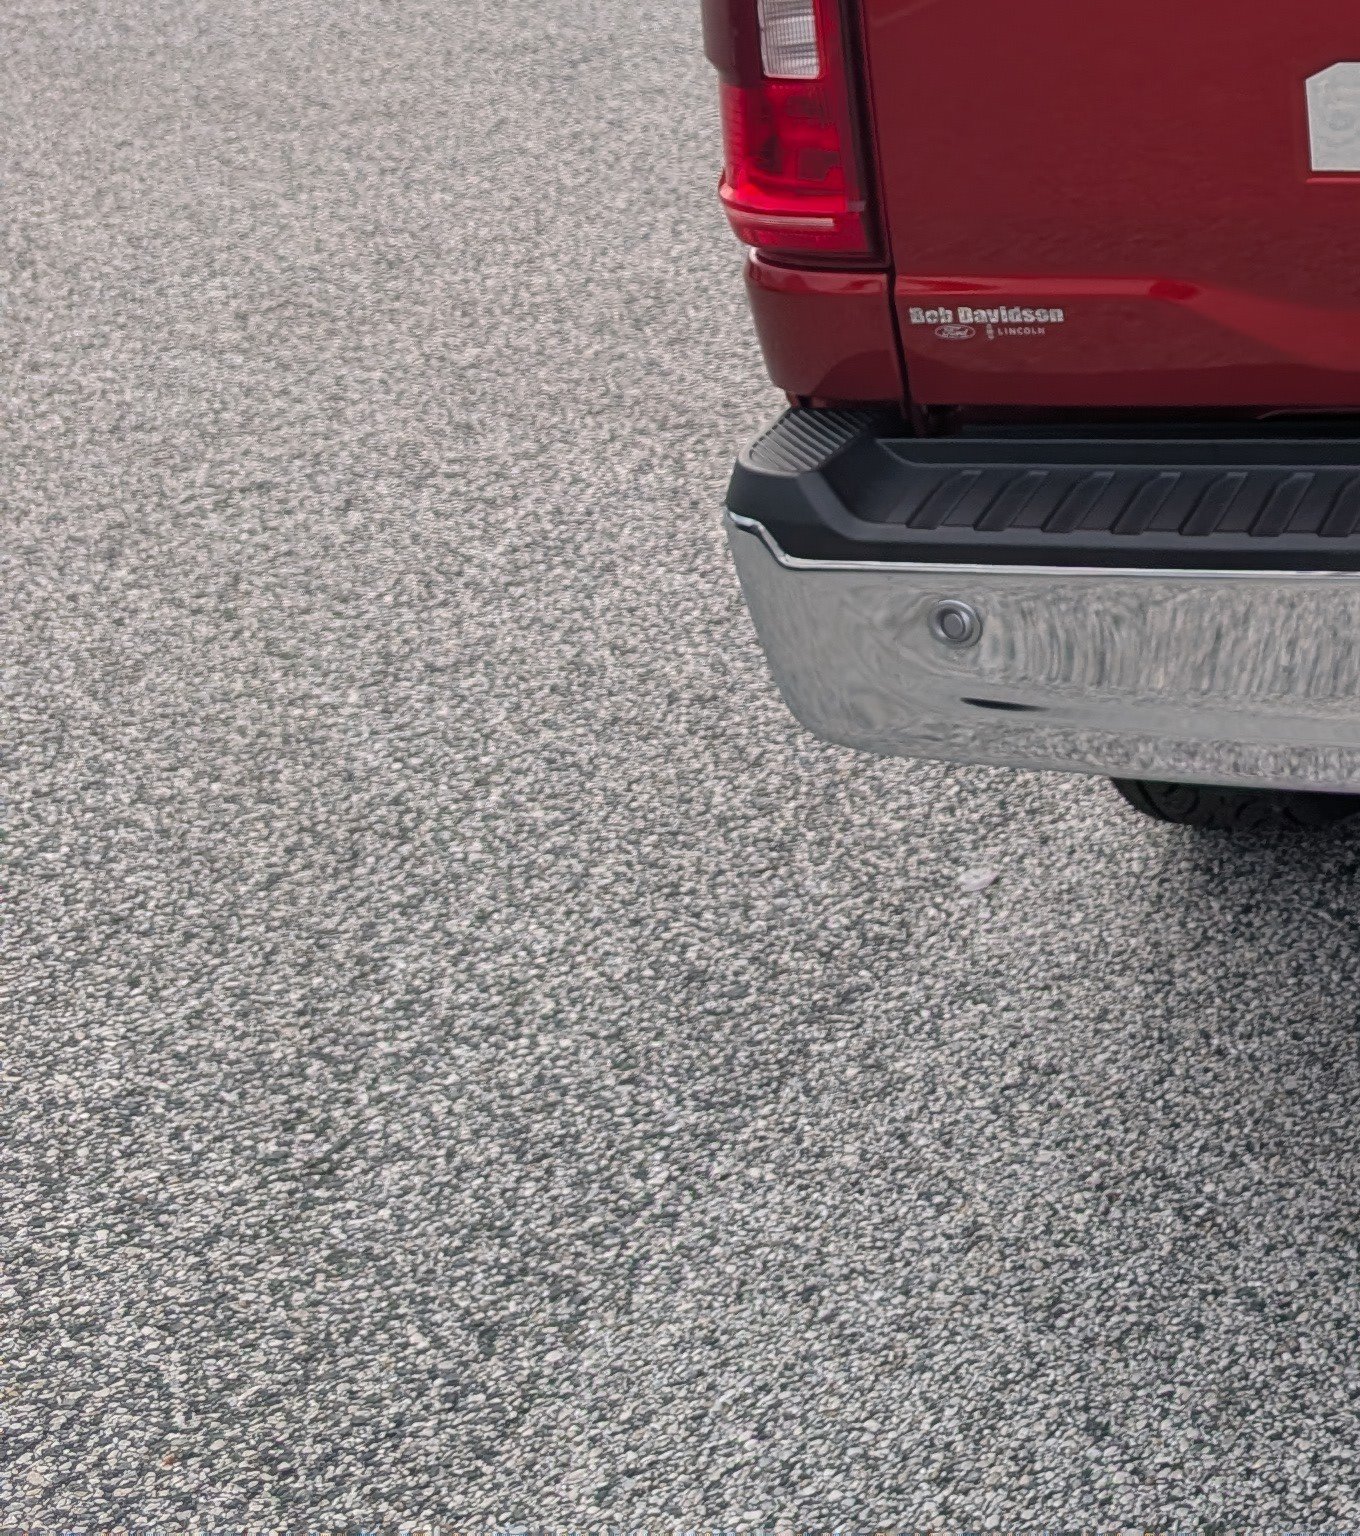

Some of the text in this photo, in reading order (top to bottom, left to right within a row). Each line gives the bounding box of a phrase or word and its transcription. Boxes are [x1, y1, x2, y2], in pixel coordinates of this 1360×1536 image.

[909, 305, 1065, 324] Bob Davidson
[997, 326, 1046, 337] LINCOLN
